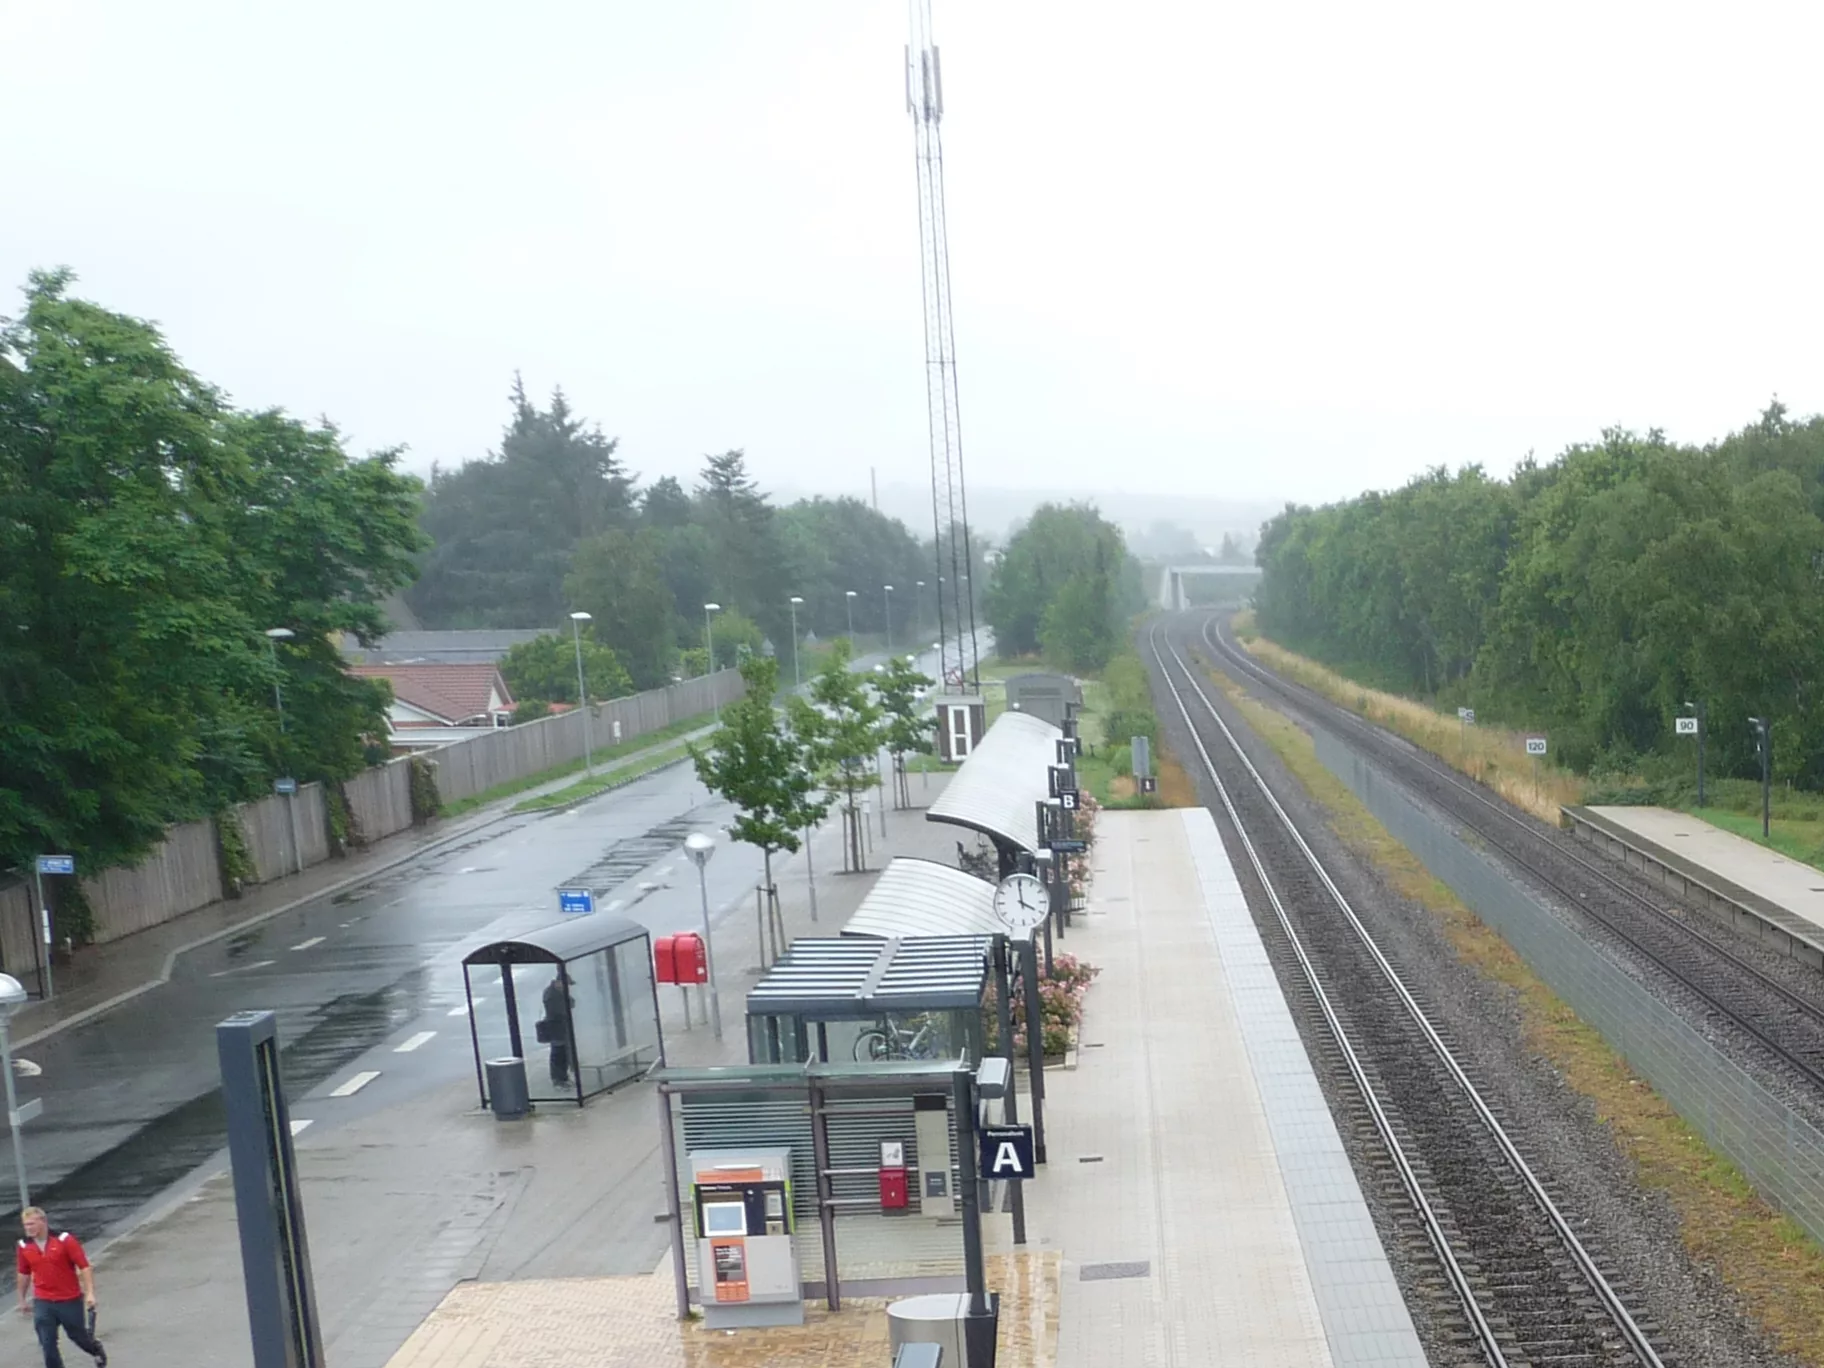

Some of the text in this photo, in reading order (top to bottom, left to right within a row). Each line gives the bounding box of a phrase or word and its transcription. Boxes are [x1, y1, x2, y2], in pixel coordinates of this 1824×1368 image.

[1680, 721, 1694, 731] 90
[1528, 742, 1545, 751] 120
[1063, 794, 1075, 808] B
[993, 1142, 1023, 1172] A
